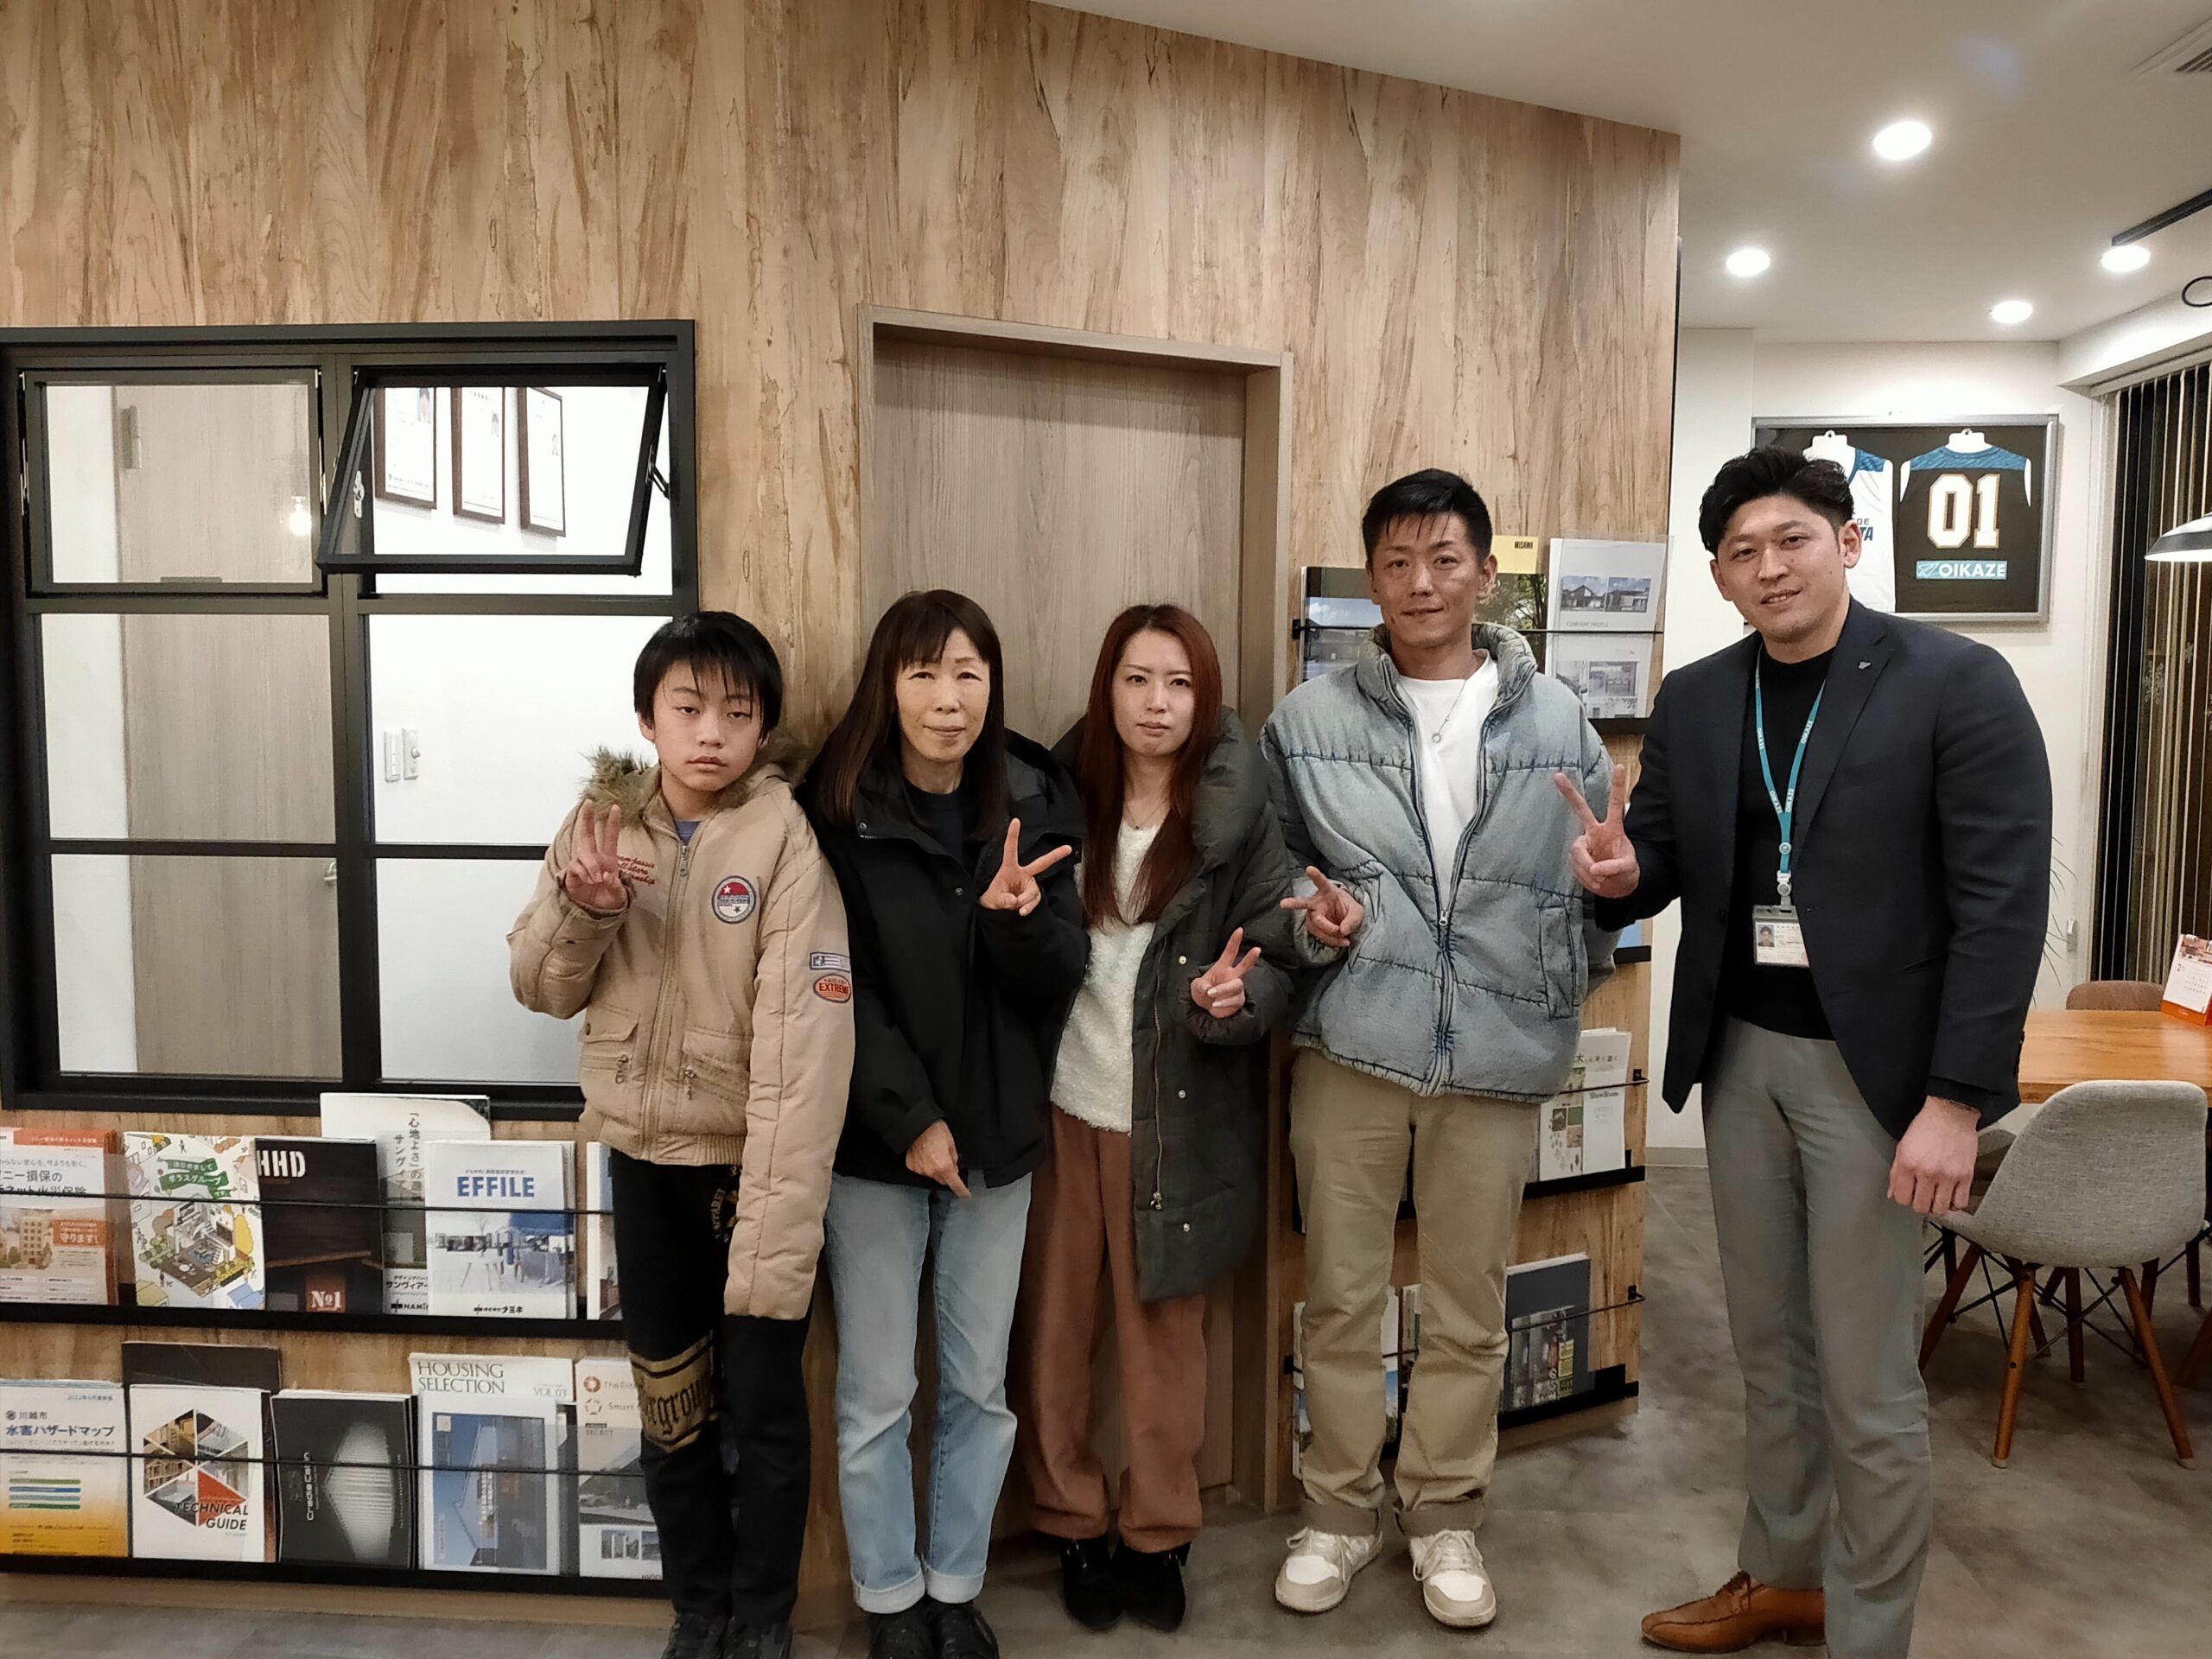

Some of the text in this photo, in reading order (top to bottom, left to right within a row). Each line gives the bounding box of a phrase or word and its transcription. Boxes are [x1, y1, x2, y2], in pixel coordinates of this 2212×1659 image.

[1927, 474, 2000, 549] 01
[1859, 526, 1873, 541] TA
[1938, 563, 2007, 578] OIKAZE
[818, 982, 849, 995] EXTREME
[173, 1161, 213, 1172] はじめまして
[0, 1170, 63, 1183] ニー損保の
[168, 1174, 221, 1185] ポラスグループ
[457, 1176, 535, 1198] EFFILE
[418, 1362, 504, 1379] HOUSING
[418, 1377, 505, 1395] SELECTION
[607, 1402, 634, 1411] Smart
[5, 1424, 116, 1437] 水害ハザードマップ
[175, 1503, 249, 1516] TECHNICAL
[206, 1517, 248, 1531] GUIDE
